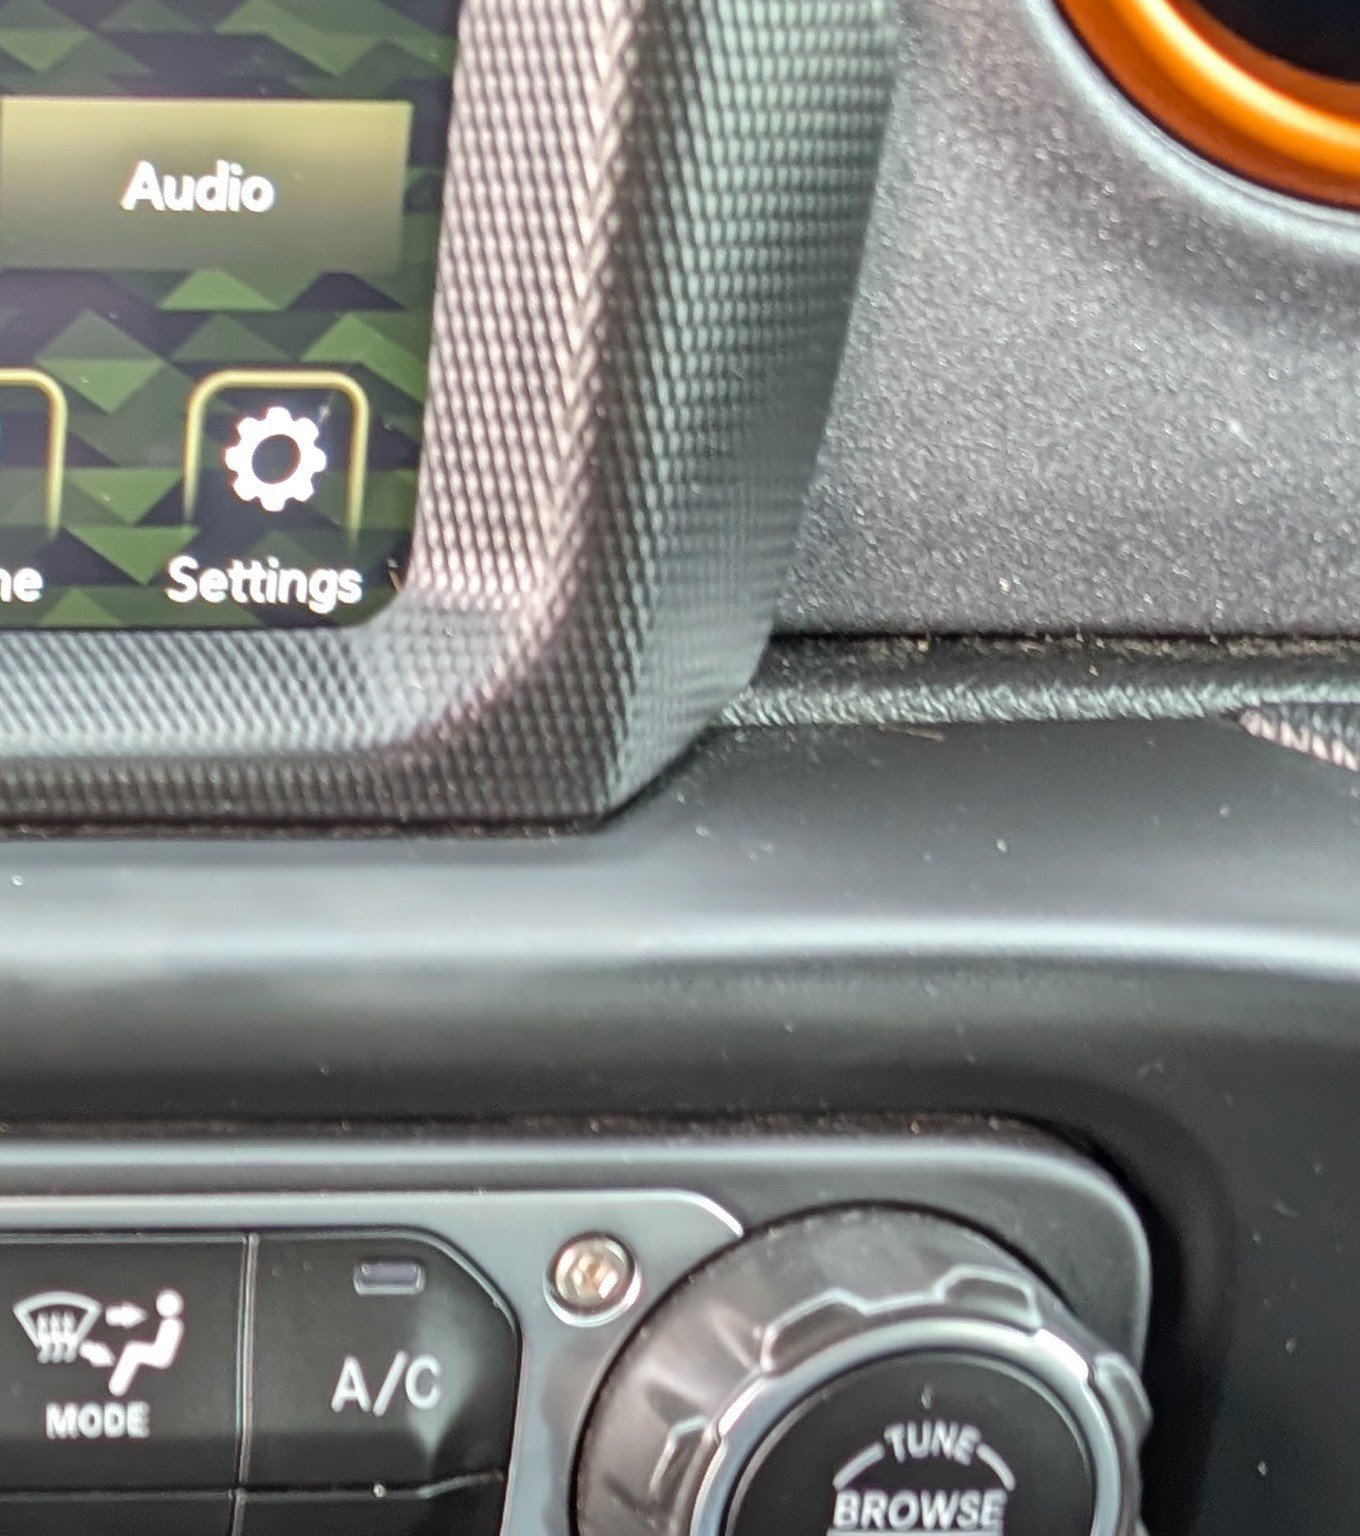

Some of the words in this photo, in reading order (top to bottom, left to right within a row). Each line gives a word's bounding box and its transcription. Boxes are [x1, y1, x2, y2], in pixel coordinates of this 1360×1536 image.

[121, 161, 276, 214] Audio
[166, 557, 363, 613] Settings
[331, 1350, 442, 1417] A/C
[44, 1402, 151, 1438] MODE
[883, 1420, 982, 1464] TUNE
[833, 1488, 1008, 1530] BROWSE
